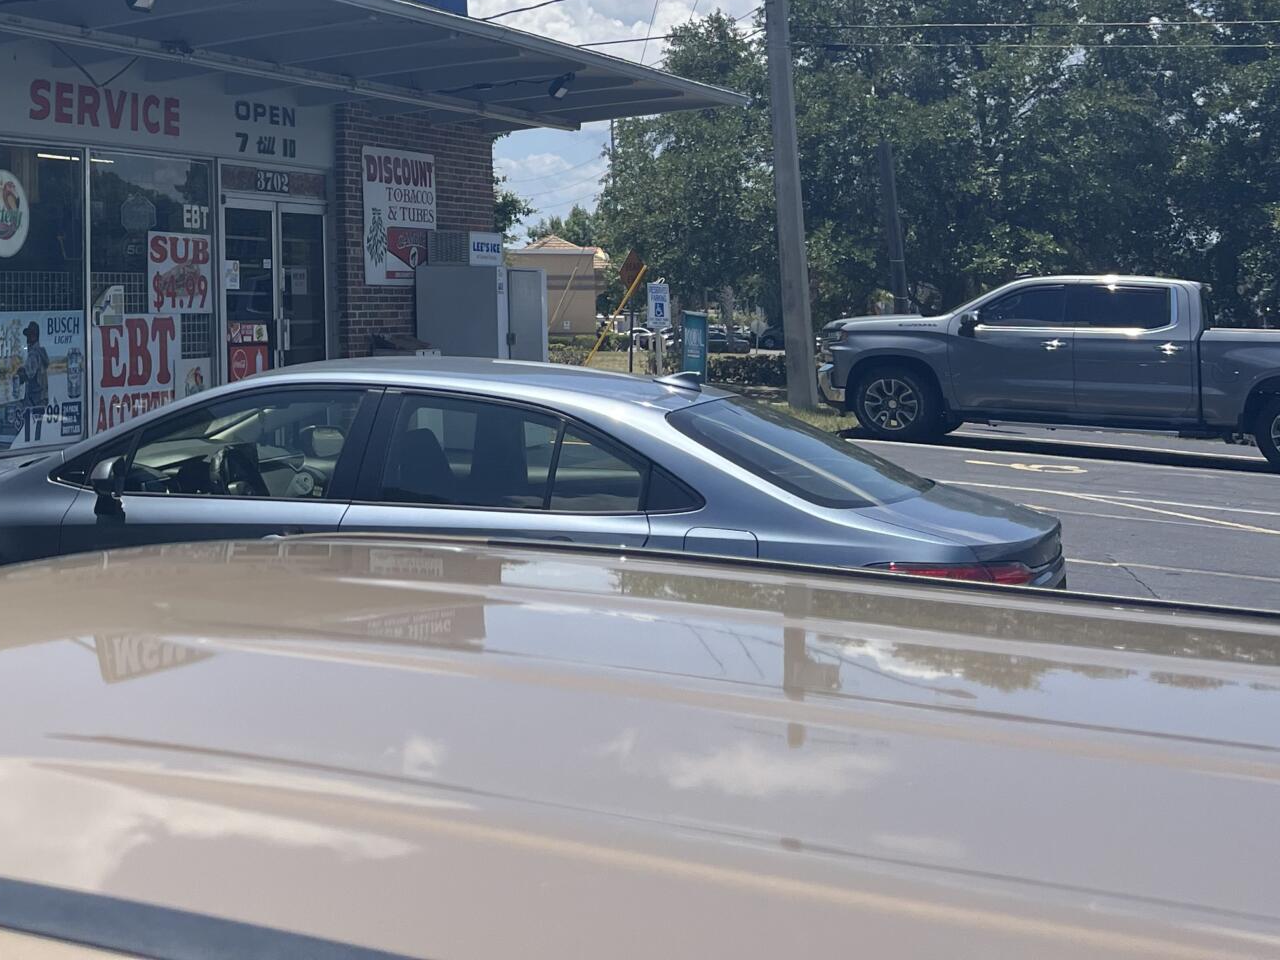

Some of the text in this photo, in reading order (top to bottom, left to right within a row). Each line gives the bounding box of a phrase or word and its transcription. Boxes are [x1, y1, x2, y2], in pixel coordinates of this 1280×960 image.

[29, 78, 181, 137] SERVICE
[234, 100, 296, 128] OPEN
[234, 131, 248, 153] 7
[256, 136, 276, 155] till
[256, 169, 289, 192] 3702
[363, 153, 434, 188] DISCOUNT
[385, 187, 434, 205] TOBACCO
[183, 203, 209, 230] EBT
[387, 206, 398, 221] &
[399, 207, 435, 224] TUBES
[149, 235, 210, 265] SUB
[472, 240, 501, 253] LEE'S ICE
[152, 271, 208, 312] $4.99
[47, 316, 80, 336] BUSCH
[54, 335, 73, 345] LIGHT
[98, 316, 176, 388] EBT
